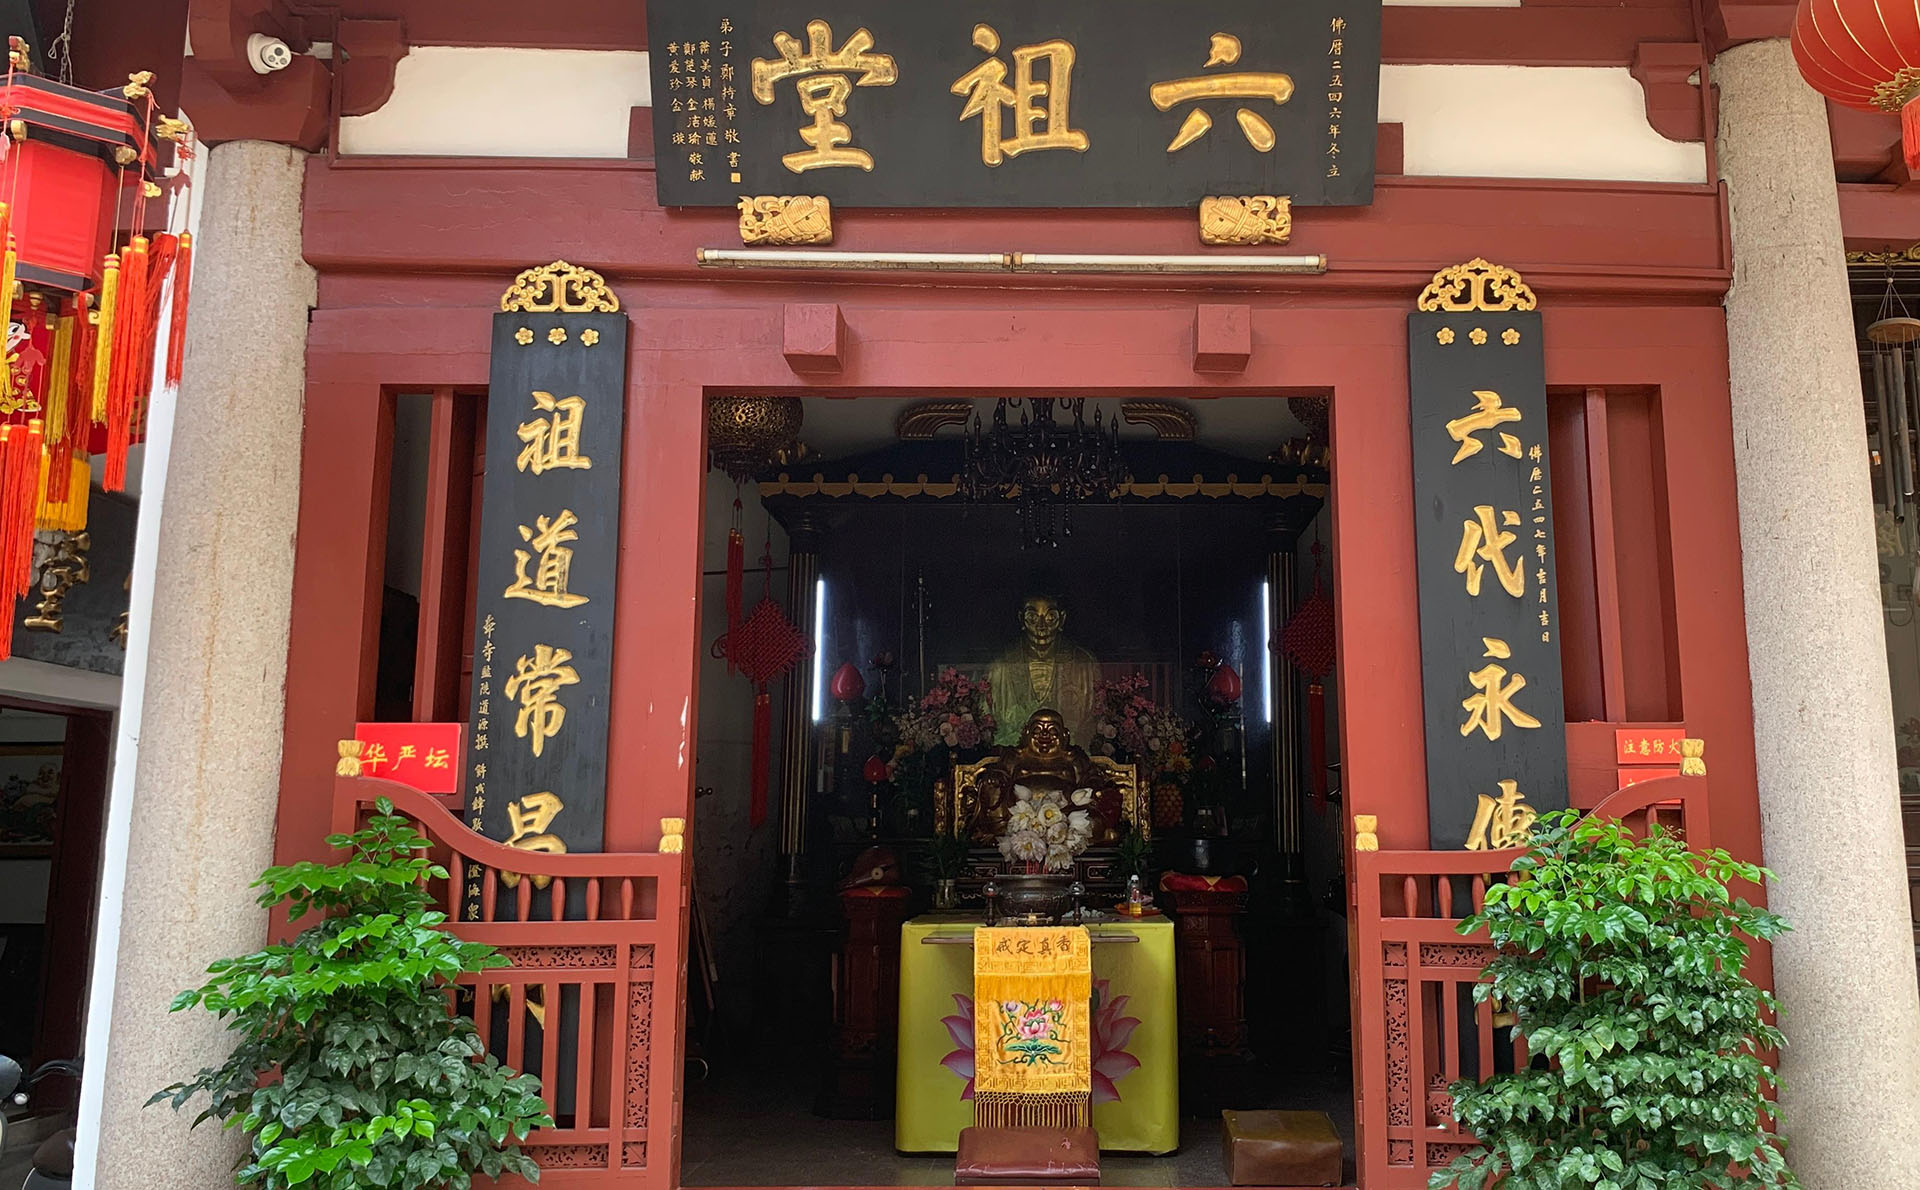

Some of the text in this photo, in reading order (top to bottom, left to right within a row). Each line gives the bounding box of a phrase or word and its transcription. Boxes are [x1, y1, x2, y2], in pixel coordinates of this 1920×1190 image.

[751, 19, 1295, 174] 六祖堂
[493, 391, 592, 1030] 祖道常昌
[1446, 391, 1541, 1029] 六代永傳
[1623, 738, 1681, 756] 注意防火
[360, 743, 449, 773] 华严坛
[996, 935, 1072, 955] 戒定真香
